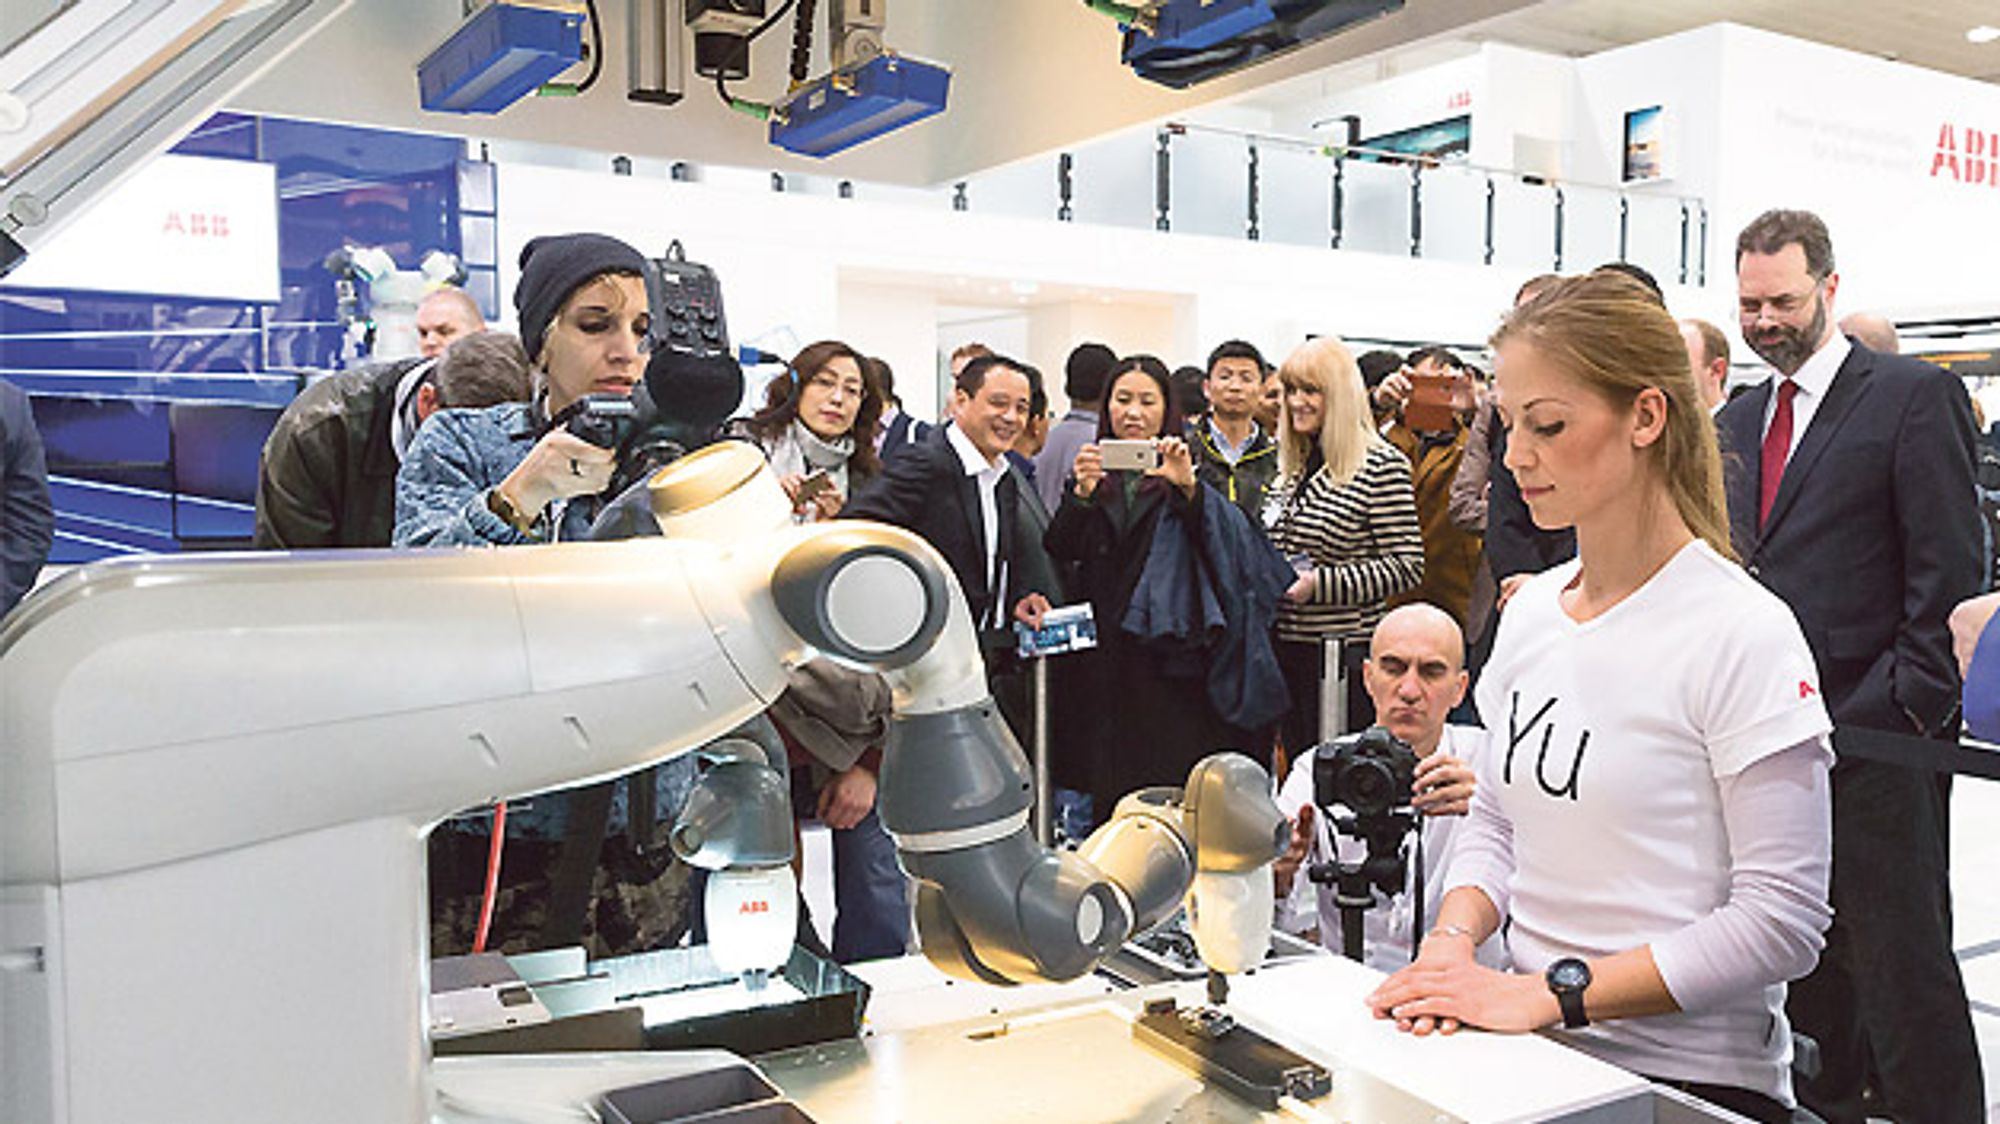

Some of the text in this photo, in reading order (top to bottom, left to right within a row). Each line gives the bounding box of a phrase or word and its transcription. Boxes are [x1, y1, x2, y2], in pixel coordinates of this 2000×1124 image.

[161, 210, 230, 238] ABB
[1504, 690, 1591, 801] Yu
[739, 900, 770, 914] ABB
